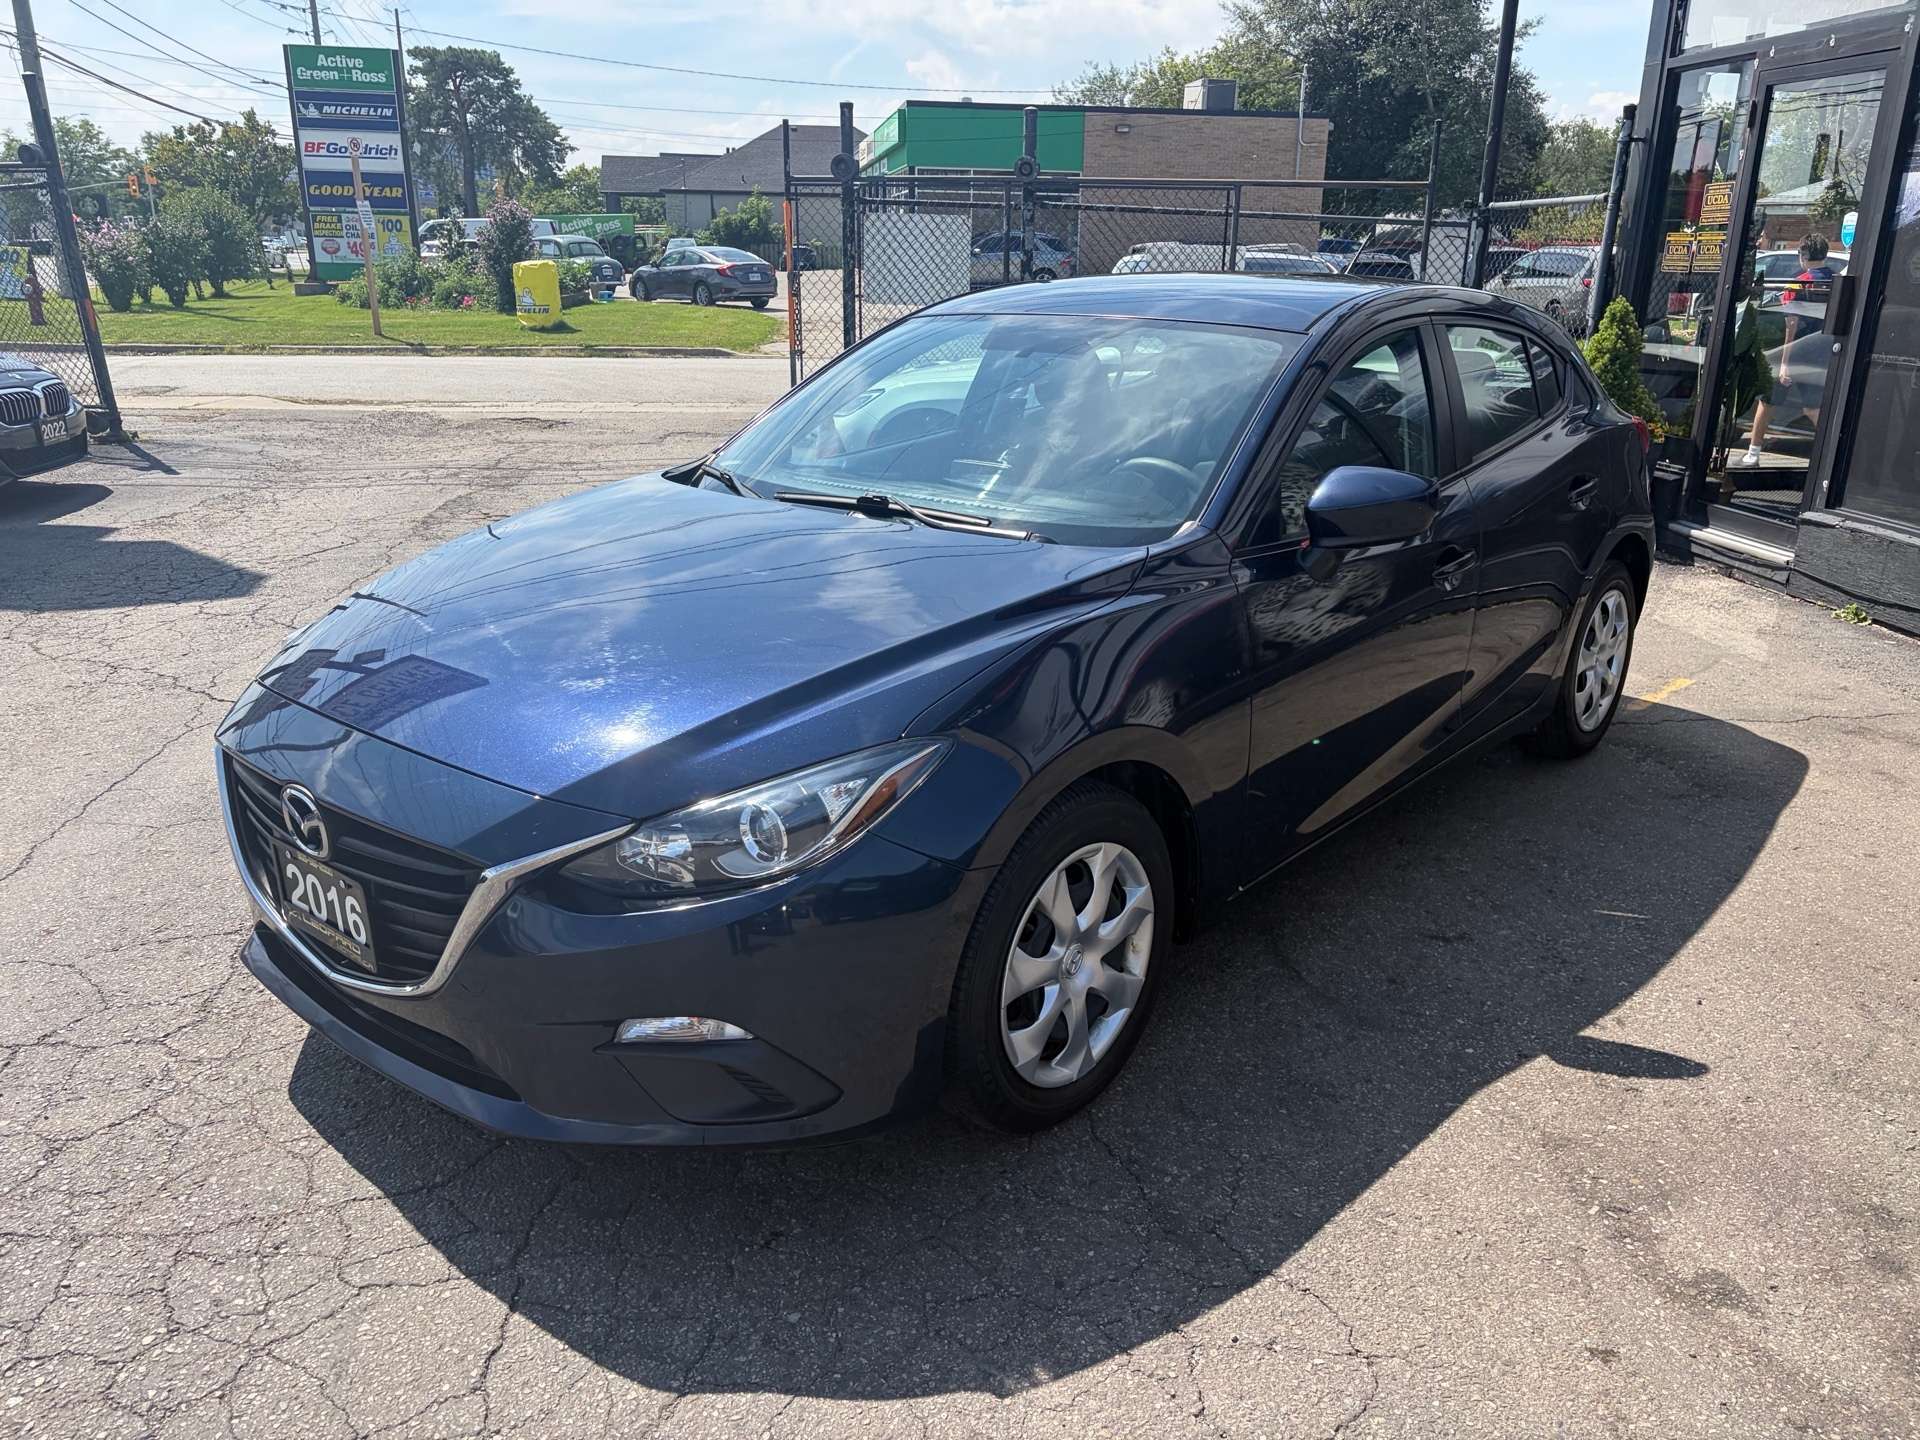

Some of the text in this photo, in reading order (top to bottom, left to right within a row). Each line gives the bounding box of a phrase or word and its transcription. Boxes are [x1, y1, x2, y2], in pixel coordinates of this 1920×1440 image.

[317, 54, 364, 68] Active
[322, 105, 393, 117] MICHELIN
[1707, 194, 1729, 205] UCDA
[561, 216, 593, 233] Active
[41, 420, 68, 440] 2022
[286, 863, 367, 945] 2016
